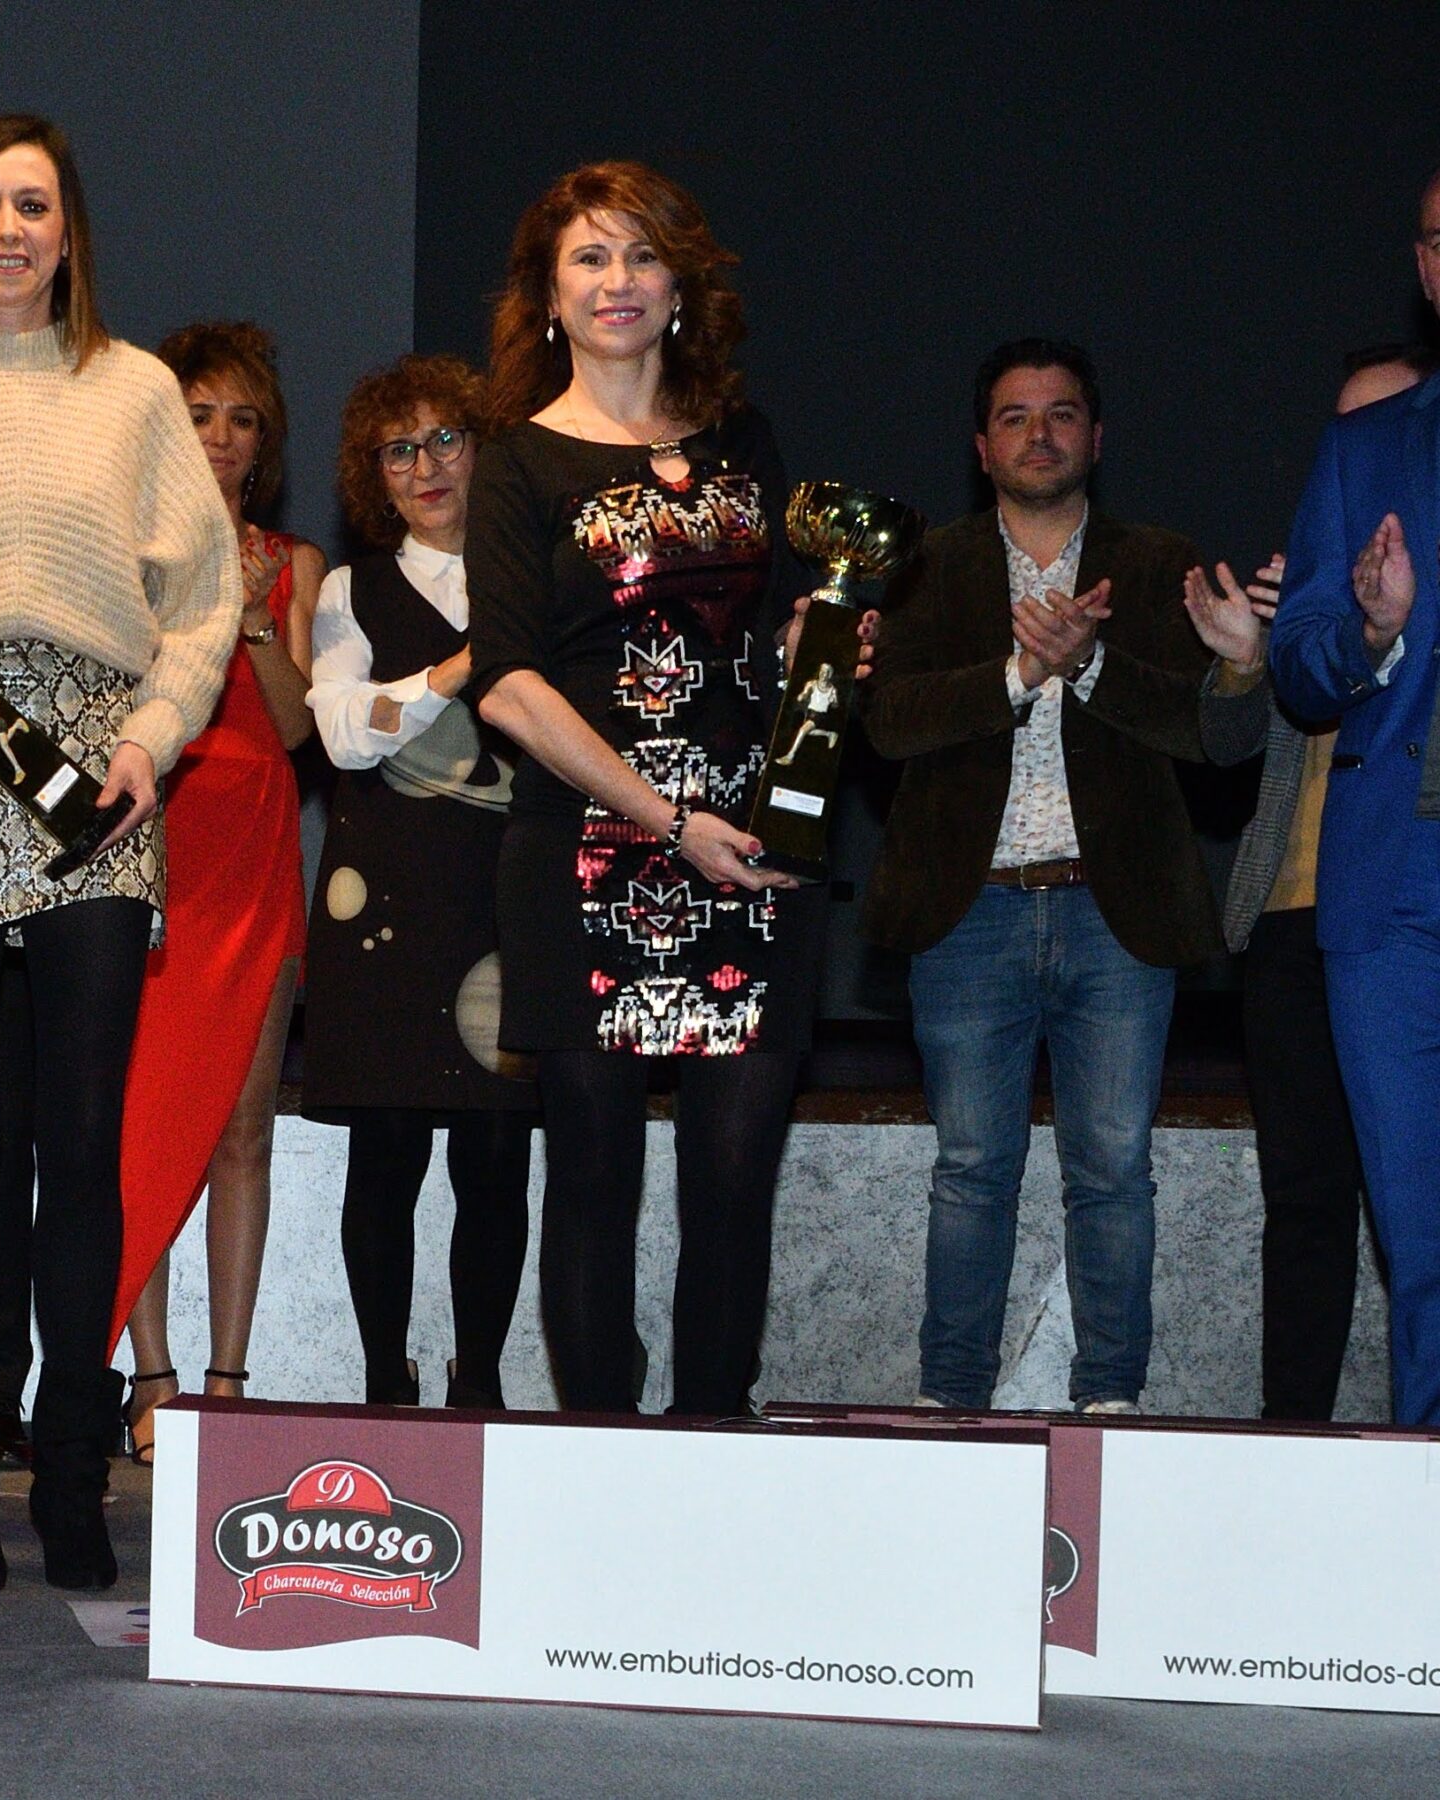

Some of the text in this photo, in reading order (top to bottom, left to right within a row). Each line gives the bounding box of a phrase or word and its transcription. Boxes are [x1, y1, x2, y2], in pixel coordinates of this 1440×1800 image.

[315, 1468, 356, 1504] D
[241, 1512, 433, 1564] Donoso
[264, 1575, 411, 1602] Charcutería Selección
[545, 1649, 974, 1688] www.embutidos-donoso.com
